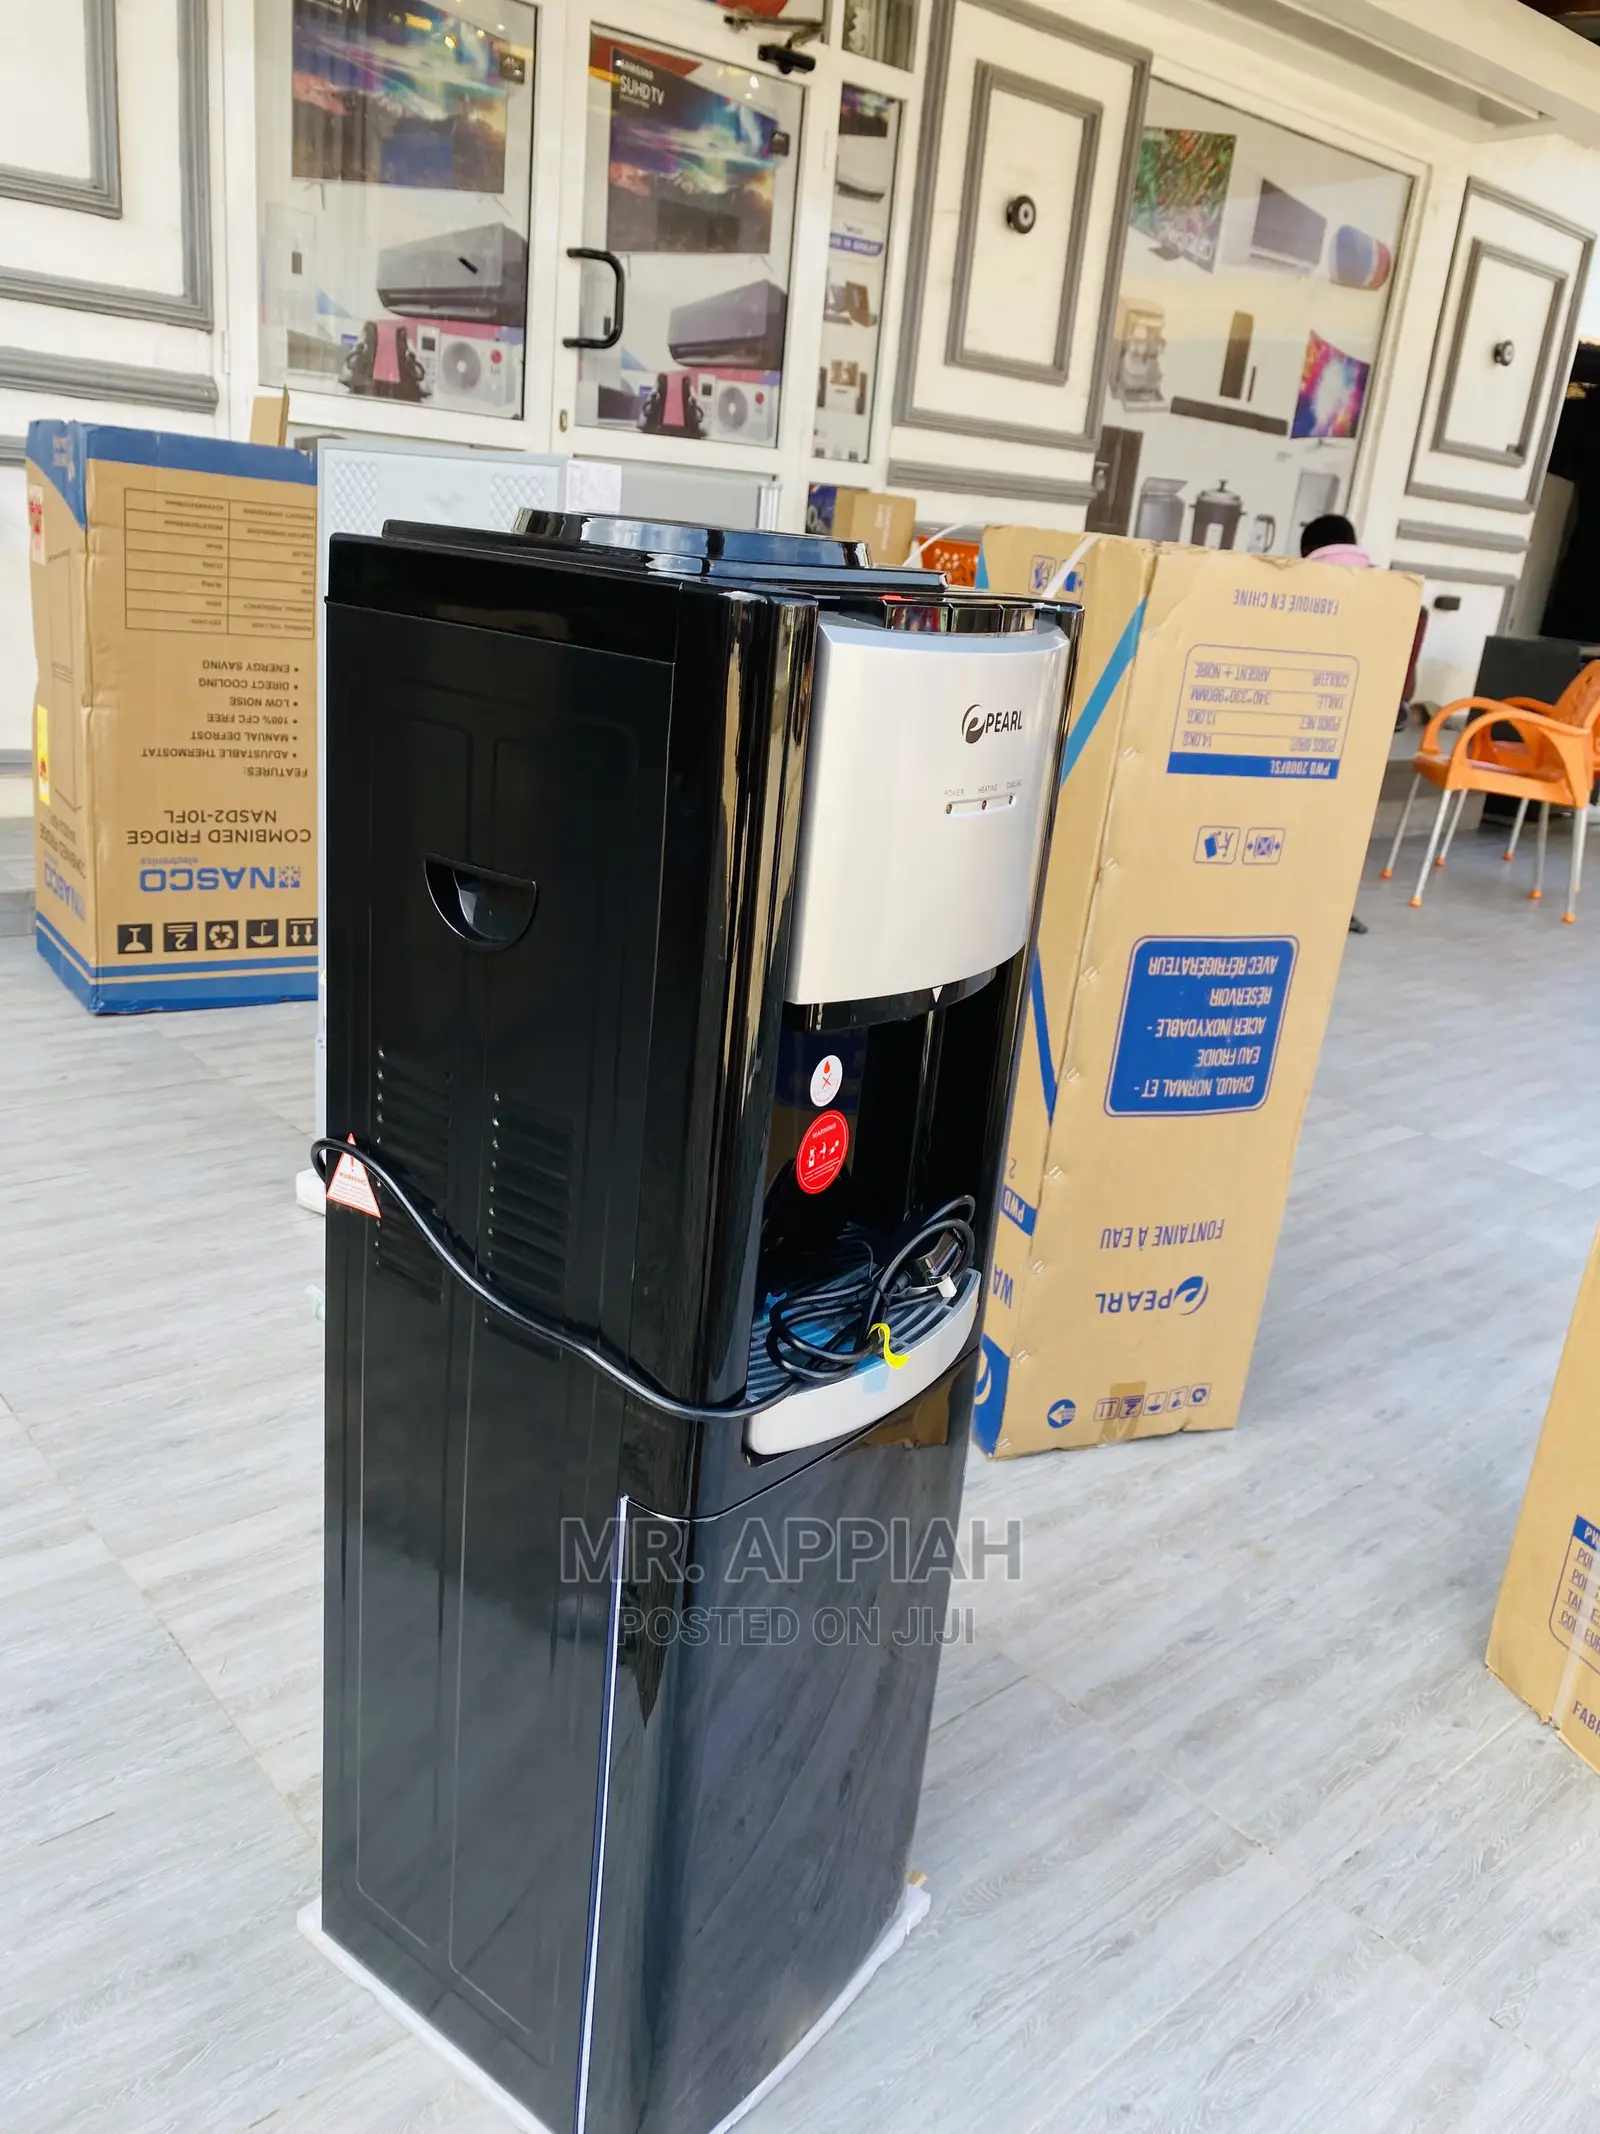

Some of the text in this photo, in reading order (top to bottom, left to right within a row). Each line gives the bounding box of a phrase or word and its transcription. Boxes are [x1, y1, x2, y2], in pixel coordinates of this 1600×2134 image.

[1232, 589, 1269, 609] CHINE
[1270, 593, 1287, 611] EN
[202, 660, 290, 673] ENERGY SAVING
[198, 678, 290, 690] DIRECT COOLING
[229, 696, 290, 708] LOW NOISE
[207, 713, 288, 725] 100% CFC FREE
[985, 709, 1023, 734] PEARL
[190, 731, 289, 742] MANUAL DEFROST
[141, 747, 288, 759] ADJUSTABLE THERMOSTAT
[243, 766, 308, 778] FEATURES:
[978, 784, 998, 794] HEATING
[163, 809, 277, 823] NASD2-10FL
[126, 829, 311, 845] COMBINED FRIDGE
[140, 867, 276, 892] NASCO
[1148, 955, 1280, 980] AVEC RÉFRIGÉRATEUR
[1209, 986, 1273, 1008] RÉSERVOIR
[1155, 1017, 1233, 1038] INOXYDABLE
[1233, 1016, 1267, 1036] ACIER
[1196, 1046, 1261, 1067] EAU FROIDE
[1141, 1079, 1159, 1098] ET
[1162, 1079, 1213, 1098] NORMAL
[812, 1122, 837, 1139] WARNING
[1003, 1190, 1026, 1224] PWD
[1099, 1227, 1133, 1250] EAU
[1151, 1218, 1225, 1247] FONTAINE
[1095, 1288, 1173, 1314] PEARL
